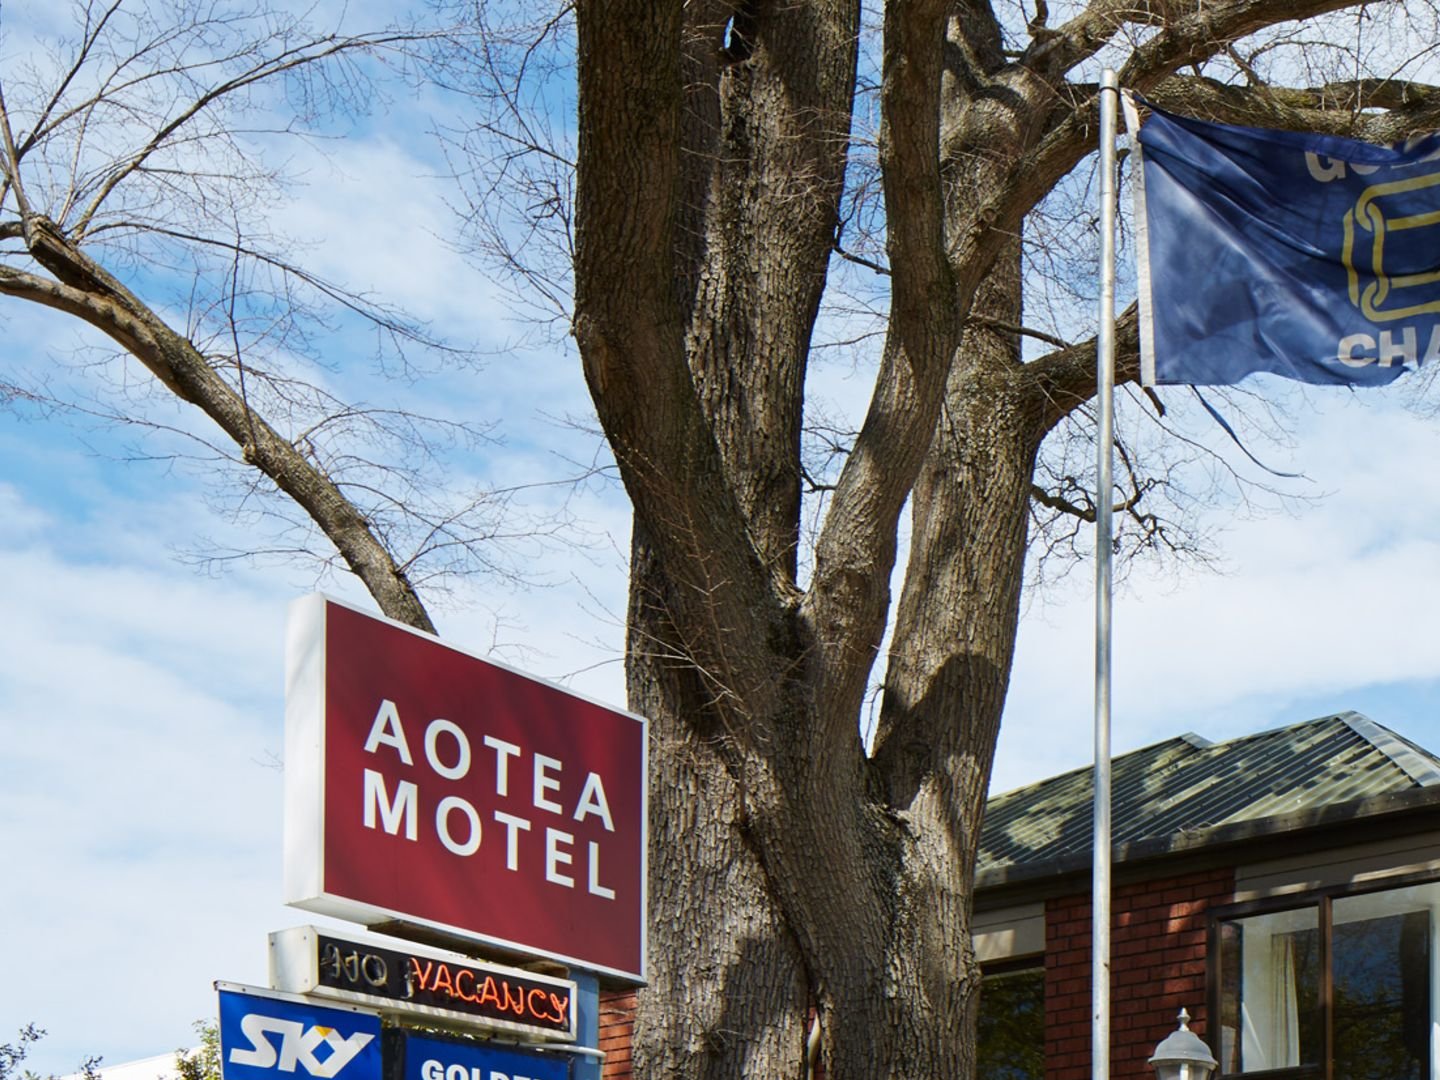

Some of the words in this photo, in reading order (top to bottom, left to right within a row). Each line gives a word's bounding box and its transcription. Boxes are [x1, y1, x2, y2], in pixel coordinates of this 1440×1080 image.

[364, 699, 615, 832] AOTEA
[363, 768, 616, 900] MOTEL
[321, 943, 388, 987] NO
[411, 957, 569, 1023] VACANCY
[229, 1013, 376, 1079] SKY
